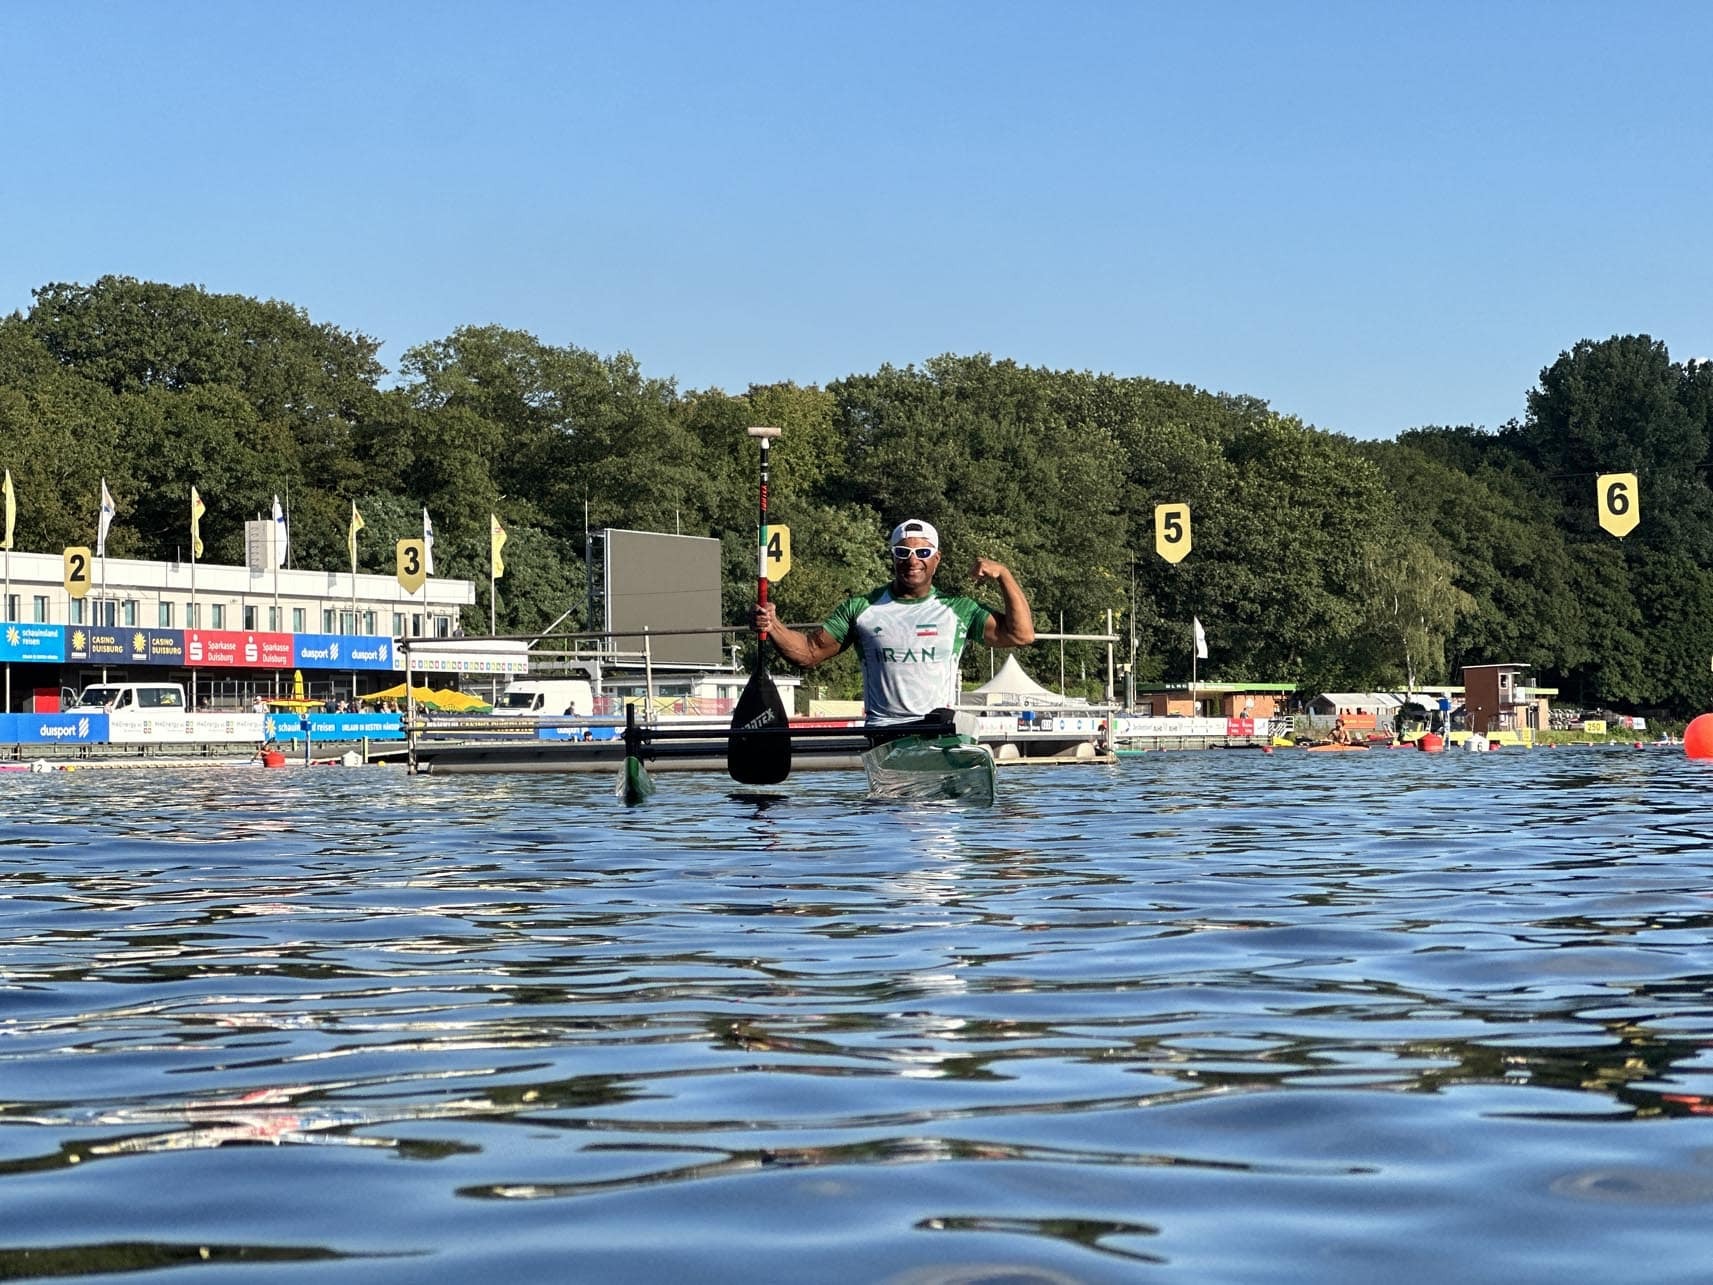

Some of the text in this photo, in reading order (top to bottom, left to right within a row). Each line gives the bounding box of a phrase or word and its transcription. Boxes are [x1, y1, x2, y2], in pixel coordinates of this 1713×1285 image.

[1607, 482, 1629, 515] 6
[1164, 511, 1183, 543] 5
[767, 532, 783, 563] 4
[404, 546, 420, 576] 3
[70, 554, 86, 582] 2
[91, 636, 115, 645] CASINO
[151, 638, 174, 646] CASINO
[207, 641, 237, 651] Sparkasse
[91, 645, 124, 654] DUISBURG
[151, 646, 182, 655] DUISBURG
[262, 642, 290, 653] Sparkasse
[301, 647, 329, 660] duisport
[207, 652, 234, 663] Duisburg
[262, 653, 287, 665] Duisburg
[351, 649, 378, 662] duisport
[875, 646, 936, 663] IRAN
[40, 724, 77, 738] duisport
[1587, 722, 1601, 731] 250
[1477, 742, 1483, 752] 6
